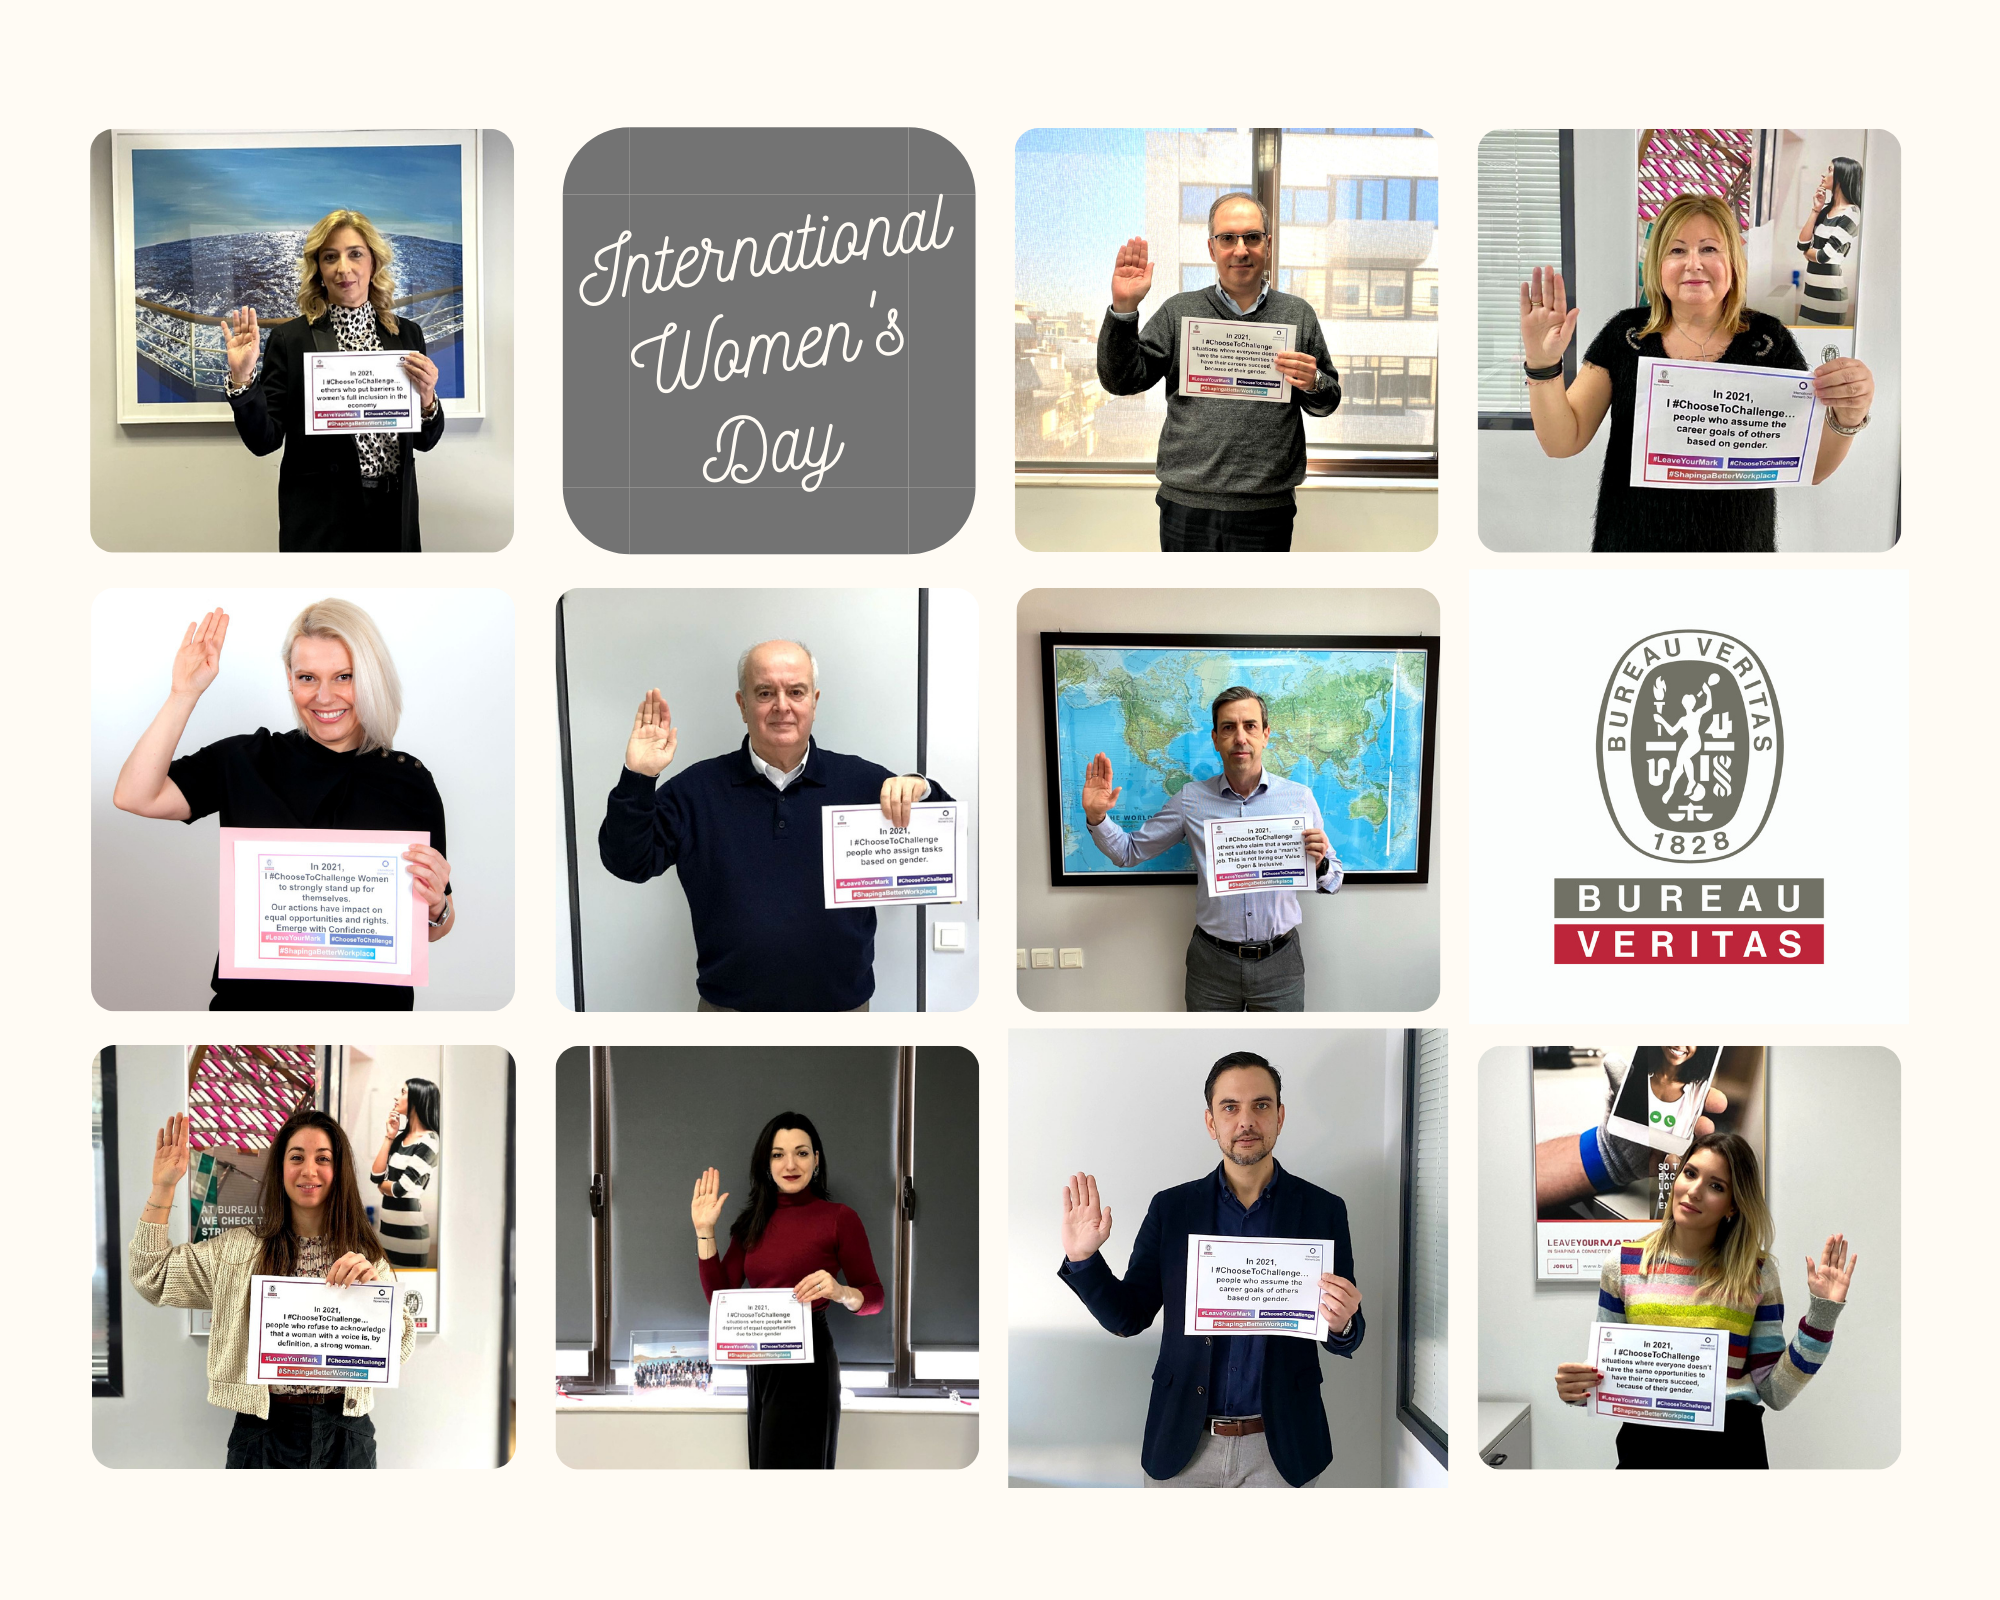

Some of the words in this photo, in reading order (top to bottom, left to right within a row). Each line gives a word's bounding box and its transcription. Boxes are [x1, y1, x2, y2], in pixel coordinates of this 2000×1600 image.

[1713, 390, 1723, 399] In
[1726, 391, 1754, 404] 2021,
[1673, 413, 1705, 423] people
[1708, 416, 1729, 425] who
[1731, 418, 1768, 428] assume
[1771, 420, 1787, 428] the
[1676, 425, 1707, 434] career
[1709, 427, 1735, 437] goals
[1738, 429, 1749, 437] of
[1750, 430, 1781, 439] others
[1687, 437, 1716, 447] based
[1718, 440, 1731, 448] on
[1733, 440, 1768, 450] gender.
[1653, 456, 1718, 466] #LeaveYourMark
[1729, 459, 1798, 467] #ChooseToChallenge
[1668, 471, 1776, 480] #ShapingaBetterWorkplace
[846, 849, 873, 857] people
[893, 847, 919, 855] assign
[921, 845, 943, 853] tasks
[861, 858, 884, 866] based
[899, 857, 928, 865] gender.
[310, 863, 319, 871] In
[321, 863, 345, 872] 2021,
[269, 873, 356, 883] #ChooseToChallenge
[358, 875, 389, 883] Women
[279, 883, 287, 891] to
[289, 884, 323, 893] strongly
[325, 884, 348, 892] stand
[350, 886, 361, 894] up
[302, 894, 350, 903] themselves.
[320, 905, 340, 913] have
[342, 905, 370, 915] impact
[264, 914, 287, 923] equal
[289, 915, 343, 925] opportunities
[362, 917, 389, 926] rights.
[276, 925, 307, 934] Emerge
[309, 925, 326, 933] with
[328, 926, 377, 934] Confidence.
[331, 936, 392, 945] #ChooseToChallenge
[279, 947, 375, 959] #ShapingaBetterWorkplace
[1658, 1163, 1669, 1171] SO
[201, 1206, 214, 1214] AT
[217, 1205, 257, 1214] BUREAU
[201, 1217, 218, 1225] WE
[221, 1216, 254, 1225] CHECK
[1256, 1258, 1277, 1267] 2021,
[340, 1325, 386, 1333] acknowledge
[1652, 1341, 1673, 1350] 2021,
[1655, 1361, 1686, 1369] everyone
[1654, 1369, 1697, 1378] opportunities
[1616, 1382, 1643, 1390] because
[1669, 1386, 1693, 1394] gender.
